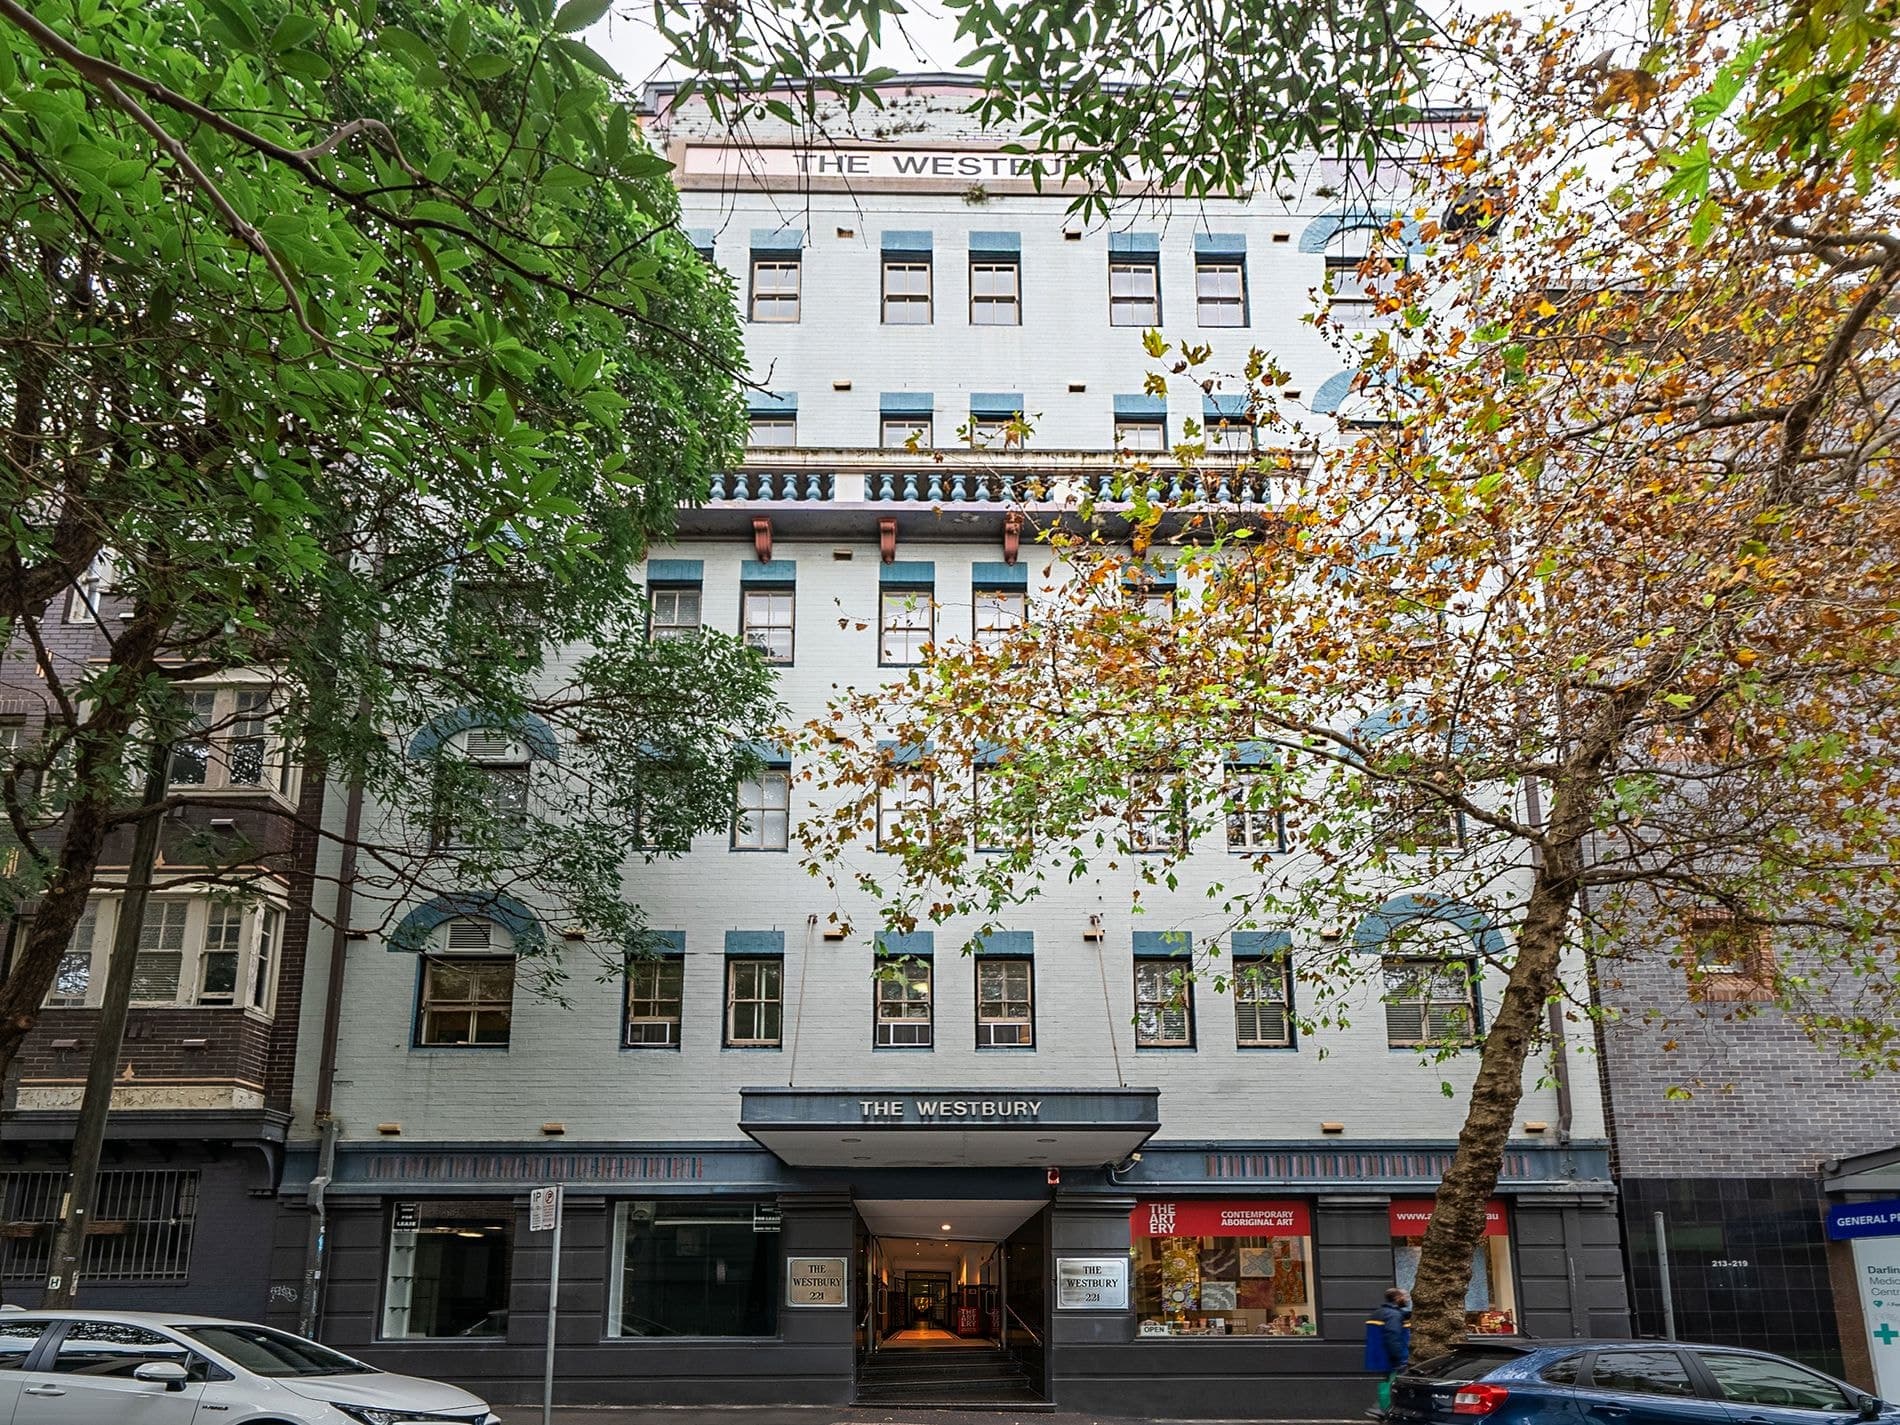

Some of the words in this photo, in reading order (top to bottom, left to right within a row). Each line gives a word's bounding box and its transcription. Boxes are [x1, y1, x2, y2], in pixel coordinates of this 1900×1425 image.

[793, 155, 870, 173] THE
[860, 1101, 904, 1116] THE
[917, 1101, 1042, 1116] WESTBURY
[1149, 1203, 1175, 1214] THE
[1150, 1214, 1176, 1224] ART
[1221, 1211, 1294, 1219] CONTEMPORARY
[1221, 1218, 1274, 1226] ABORIGINAL
[1277, 1218, 1293, 1226] ART
[1837, 1214, 1887, 1227] GENERAL
[1150, 1223, 1175, 1234] ERY
[808, 1265, 826, 1273] THE
[1083, 1266, 1102, 1274] THE
[793, 1278, 841, 1286] WESTBURY
[1067, 1279, 1118, 1287] WESTBURY
[809, 1292, 824, 1300] 221
